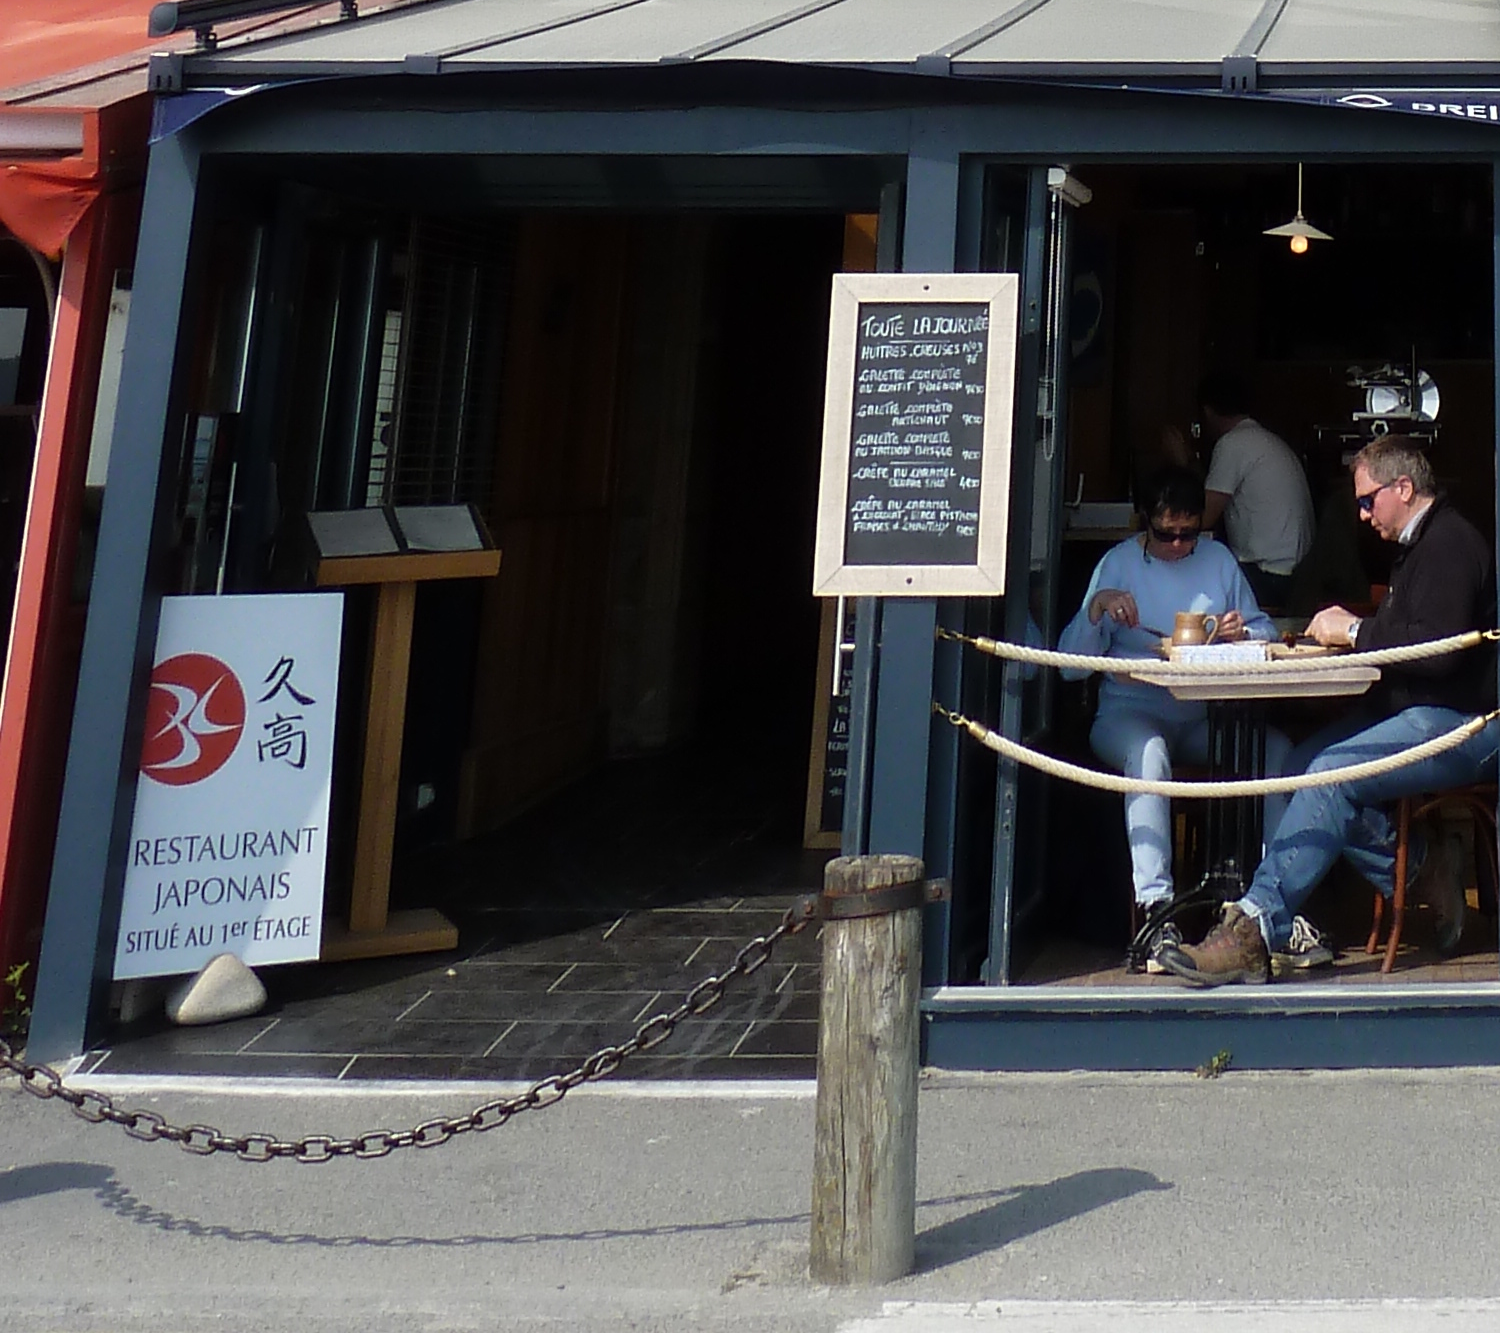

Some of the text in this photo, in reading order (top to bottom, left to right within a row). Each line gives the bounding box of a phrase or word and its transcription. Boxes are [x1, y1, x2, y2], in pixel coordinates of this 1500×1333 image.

[860, 314, 906, 337] TOUTE
[256, 655, 316, 770] 久高
[134, 827, 319, 867] RESTAURANT
[152, 872, 291, 915] JAPONAIS
[125, 914, 312, 954] SITUÉ AU 1er ÉTAGE
